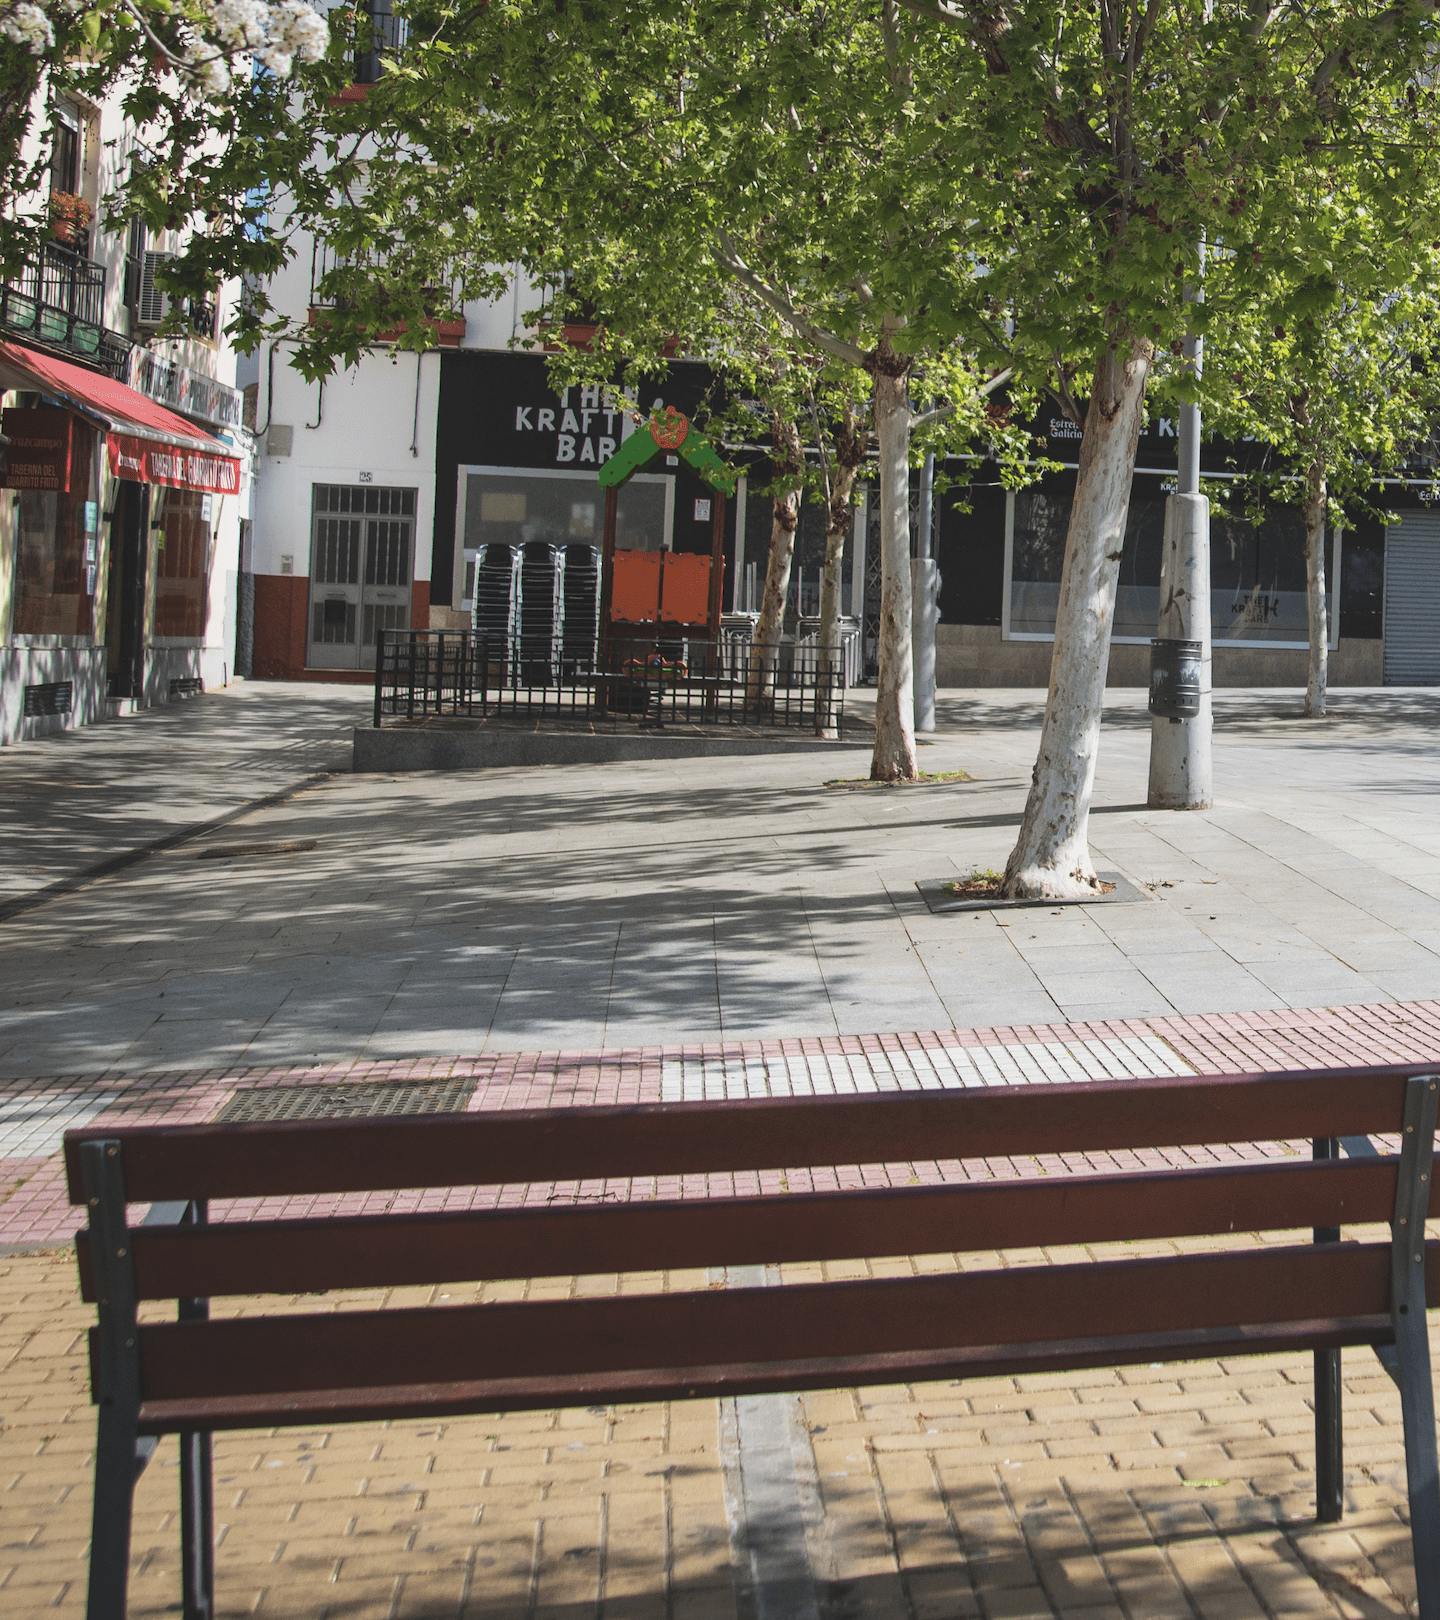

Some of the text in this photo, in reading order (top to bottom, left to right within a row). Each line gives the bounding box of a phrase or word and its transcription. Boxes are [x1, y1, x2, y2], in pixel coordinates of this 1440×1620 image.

[516, 406, 619, 434] KRAFT
[1050, 418, 1079, 429] Estrel
[1050, 428, 1083, 439] Galicia
[9, 436, 63, 450] ruzcampo
[556, 434, 617, 464] BAR
[11, 463, 56, 476] TABERNA DEL
[151, 452, 236, 490] TABERNA DEL GUARRITO FRITO
[6, 475, 59, 488] GUARRITO FRITO
